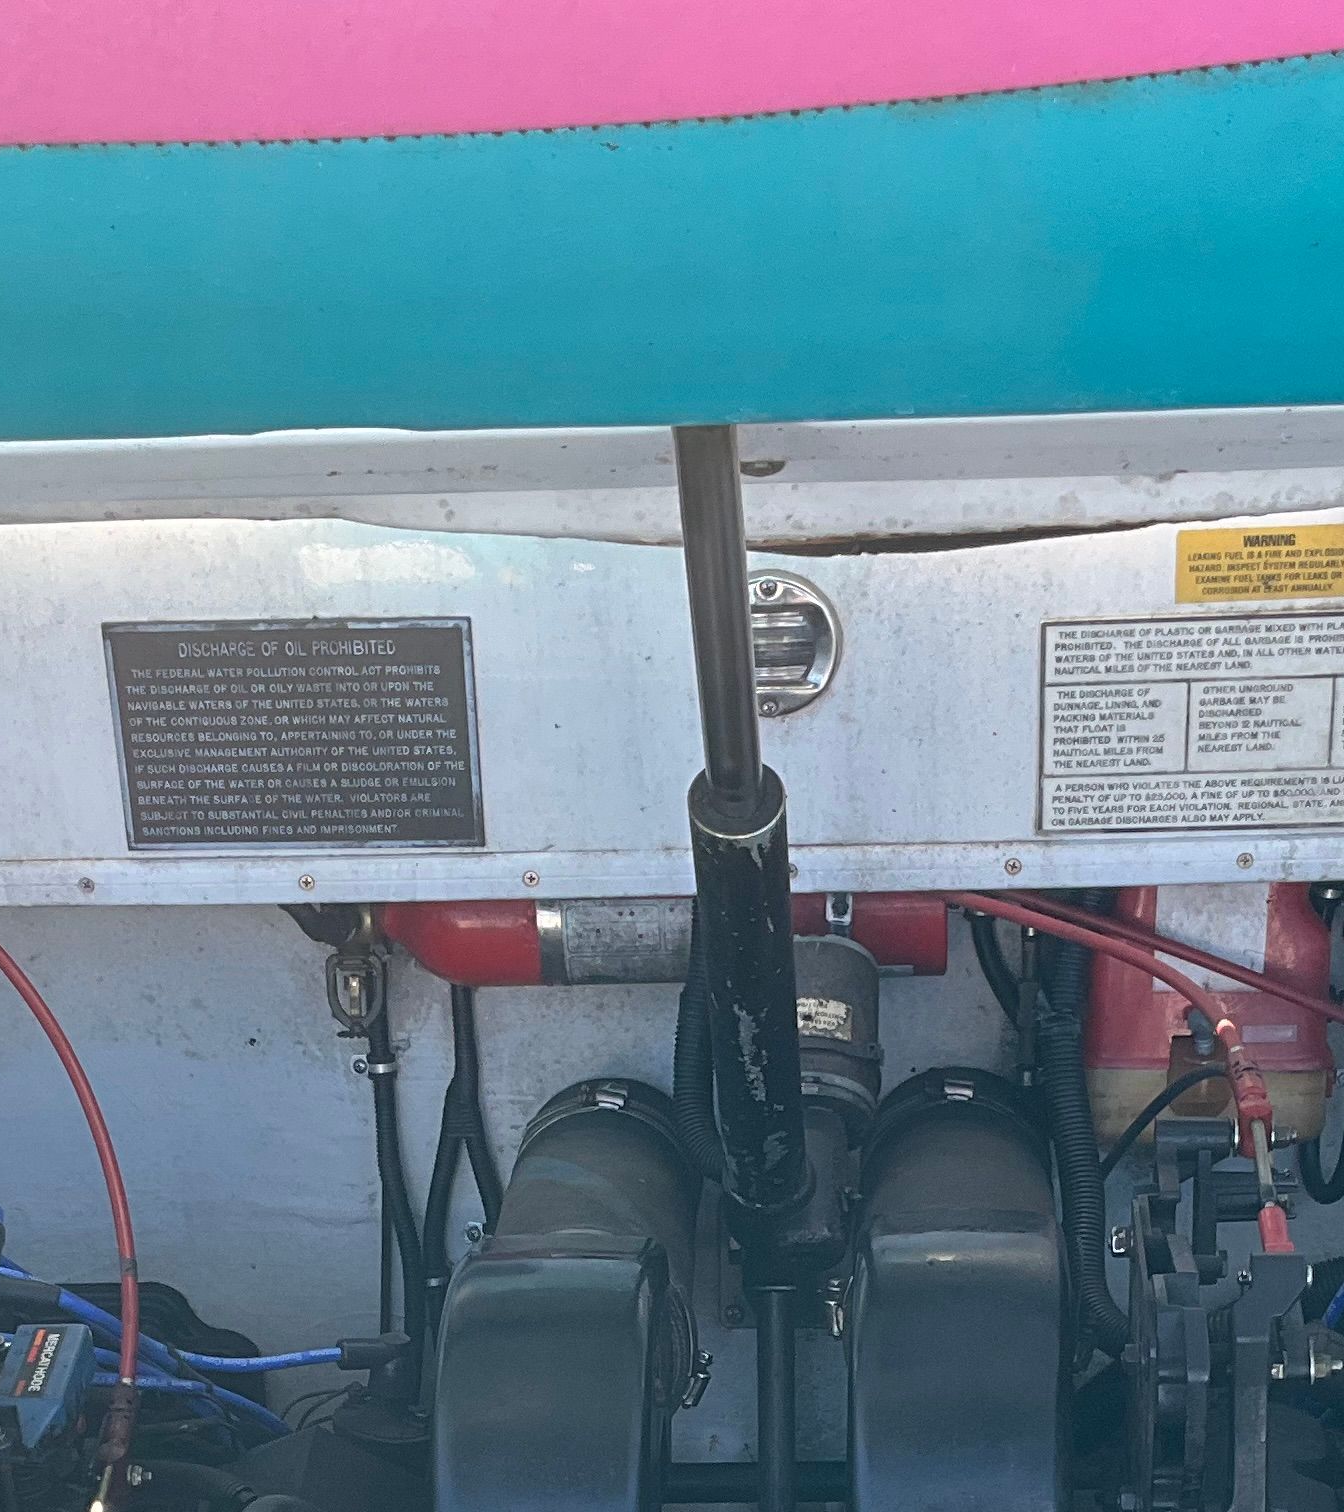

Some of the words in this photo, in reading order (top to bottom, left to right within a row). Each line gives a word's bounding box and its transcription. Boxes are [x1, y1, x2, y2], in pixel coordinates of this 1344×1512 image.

[1243, 534, 1295, 547] WARNING
[178, 642, 256, 657] DISCHARGE
[261, 642, 278, 656] OF
[285, 642, 307, 656] OIL
[312, 641, 396, 656] PROHIBITED
[131, 669, 153, 679] THE
[155, 668, 205, 678] FEDERAL
[206, 668, 244, 678] WATER
[246, 667, 306, 677] POLLUTION
[309, 667, 359, 677] CONTROL
[361, 666, 382, 676] ACT
[384, 666, 441, 676] PROHIBITS
[125, 685, 147, 695] THE
[149, 685, 211, 695] DISCHARGE
[213, 684, 228, 694] OF
[230, 684, 247, 694] OIL
[250, 684, 266, 694] OR
[269, 683, 294, 693] OILY
[296, 683, 332, 693] WASTE
[335, 682, 361, 692] INTO
[362, 682, 378, 692] OR
[380, 682, 410, 692] UPON
[412, 681, 434, 691] THE
[127, 701, 186, 711] NAVIGABLE
[188, 700, 233, 711] WATERS
[235, 700, 249, 710] OF
[252, 700, 273, 710] THE
[275, 699, 314, 709] UNITED
[363, 699, 378, 708] OR
[380, 698, 402, 708] THE
[405, 698, 449, 708] WATERS
[128, 717, 143, 727] OF
[145, 717, 167, 727] THE
[170, 716, 238, 727] CONTIGUOUS
[274, 716, 290, 725] OR
[292, 715, 326, 725] WHICH
[328, 715, 351, 725] MAY
[354, 714, 395, 725] AFFECT
[397, 714, 447, 724] NATURAL
[130, 732, 195, 743] RESOURCES
[197, 732, 257, 742] BELONGING
[281, 730, 356, 741] APPERTAINING
[378, 730, 394, 740] OR
[396, 729, 433, 739] UNDER
[436, 729, 457, 739] THE
[132, 748, 192, 758] EXCLUSIVE
[194, 747, 268, 758] MANAGEMENT
[270, 747, 328, 757] AUTHORITY
[331, 747, 345, 756] OF
[348, 746, 369, 756] THE
[372, 746, 410, 756] UNITED
[134, 765, 145, 774] IF
[147, 764, 176, 774] SUCH
[178, 764, 239, 774] DISCHARGE
[286, 763, 294, 773] A
[296, 763, 321, 773] FILM
[323, 762, 338, 772] OR
[341, 761, 425, 772] DISCOLORATION
[427, 761, 442, 771] OF
[444, 761, 465, 771] THE
[136, 780, 185, 790] SURFACE
[187, 780, 202, 789] OF
[204, 779, 226, 789] THE
[228, 779, 265, 789] WATER
[267, 779, 282, 789] OR
[330, 778, 338, 788] A
[340, 778, 381, 788] SLUDGE
[384, 778, 399, 788] OR
[142, 826, 201, 836] SANCTIONS
[203, 826, 259, 836] INCLUDING
[262, 825, 294, 835] FINES
[297, 825, 317, 835] AND
[28, 1333, 60, 1392] MERCATHODE
